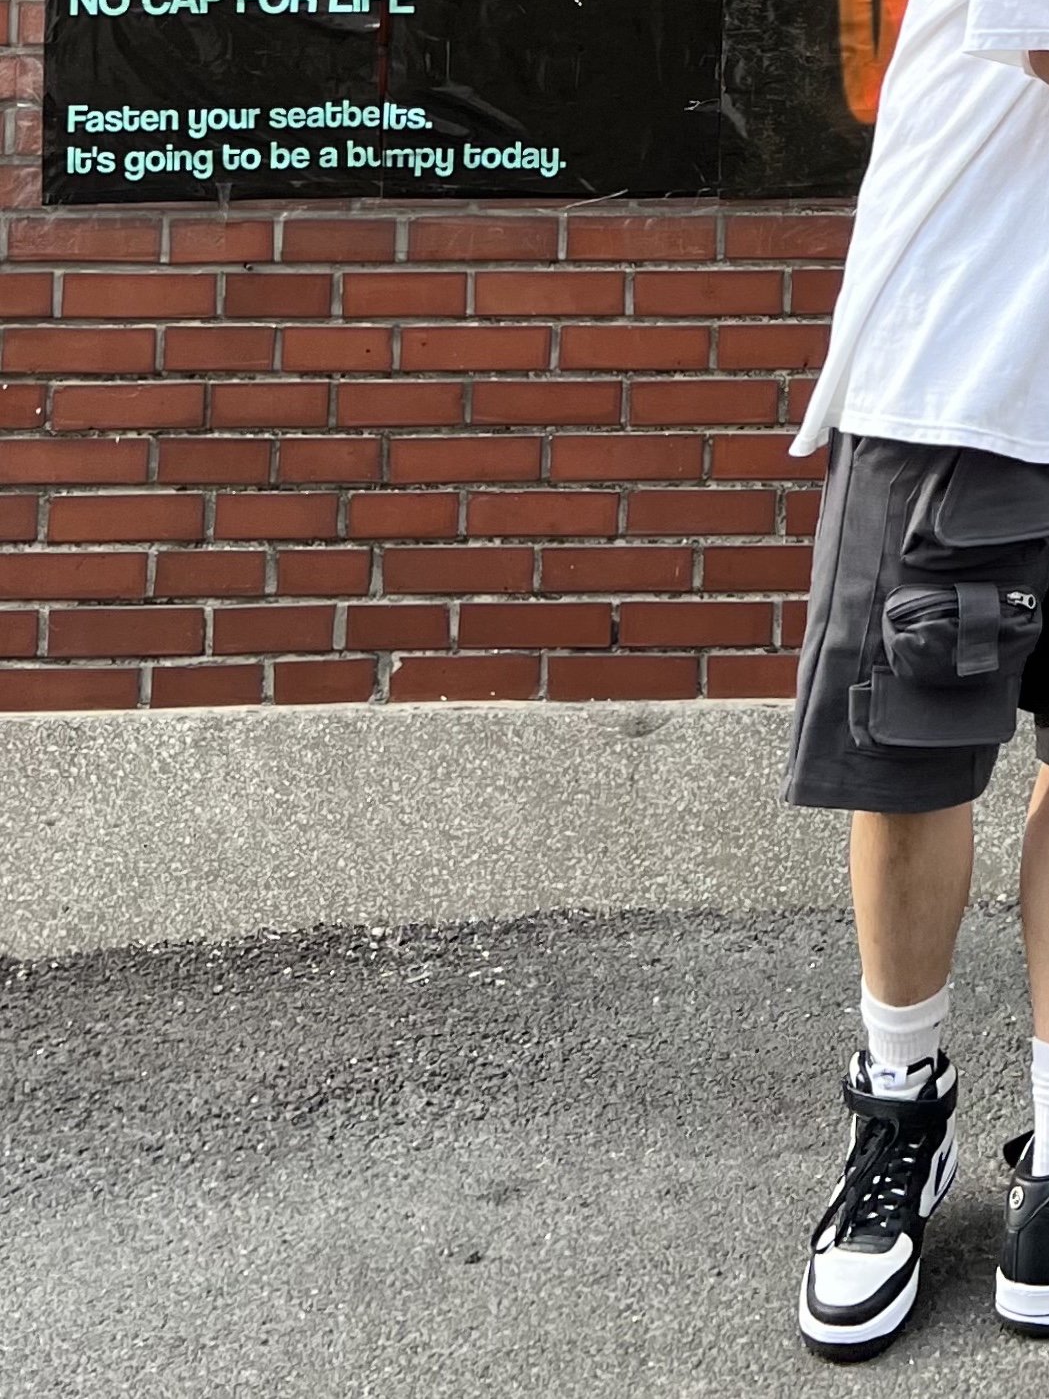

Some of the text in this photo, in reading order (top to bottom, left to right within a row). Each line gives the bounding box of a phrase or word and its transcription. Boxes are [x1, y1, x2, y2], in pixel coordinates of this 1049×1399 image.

[66, 101, 433, 138] Fasten your seatbelts.
[66, 140, 567, 181] It's going to be a bumpy today.
